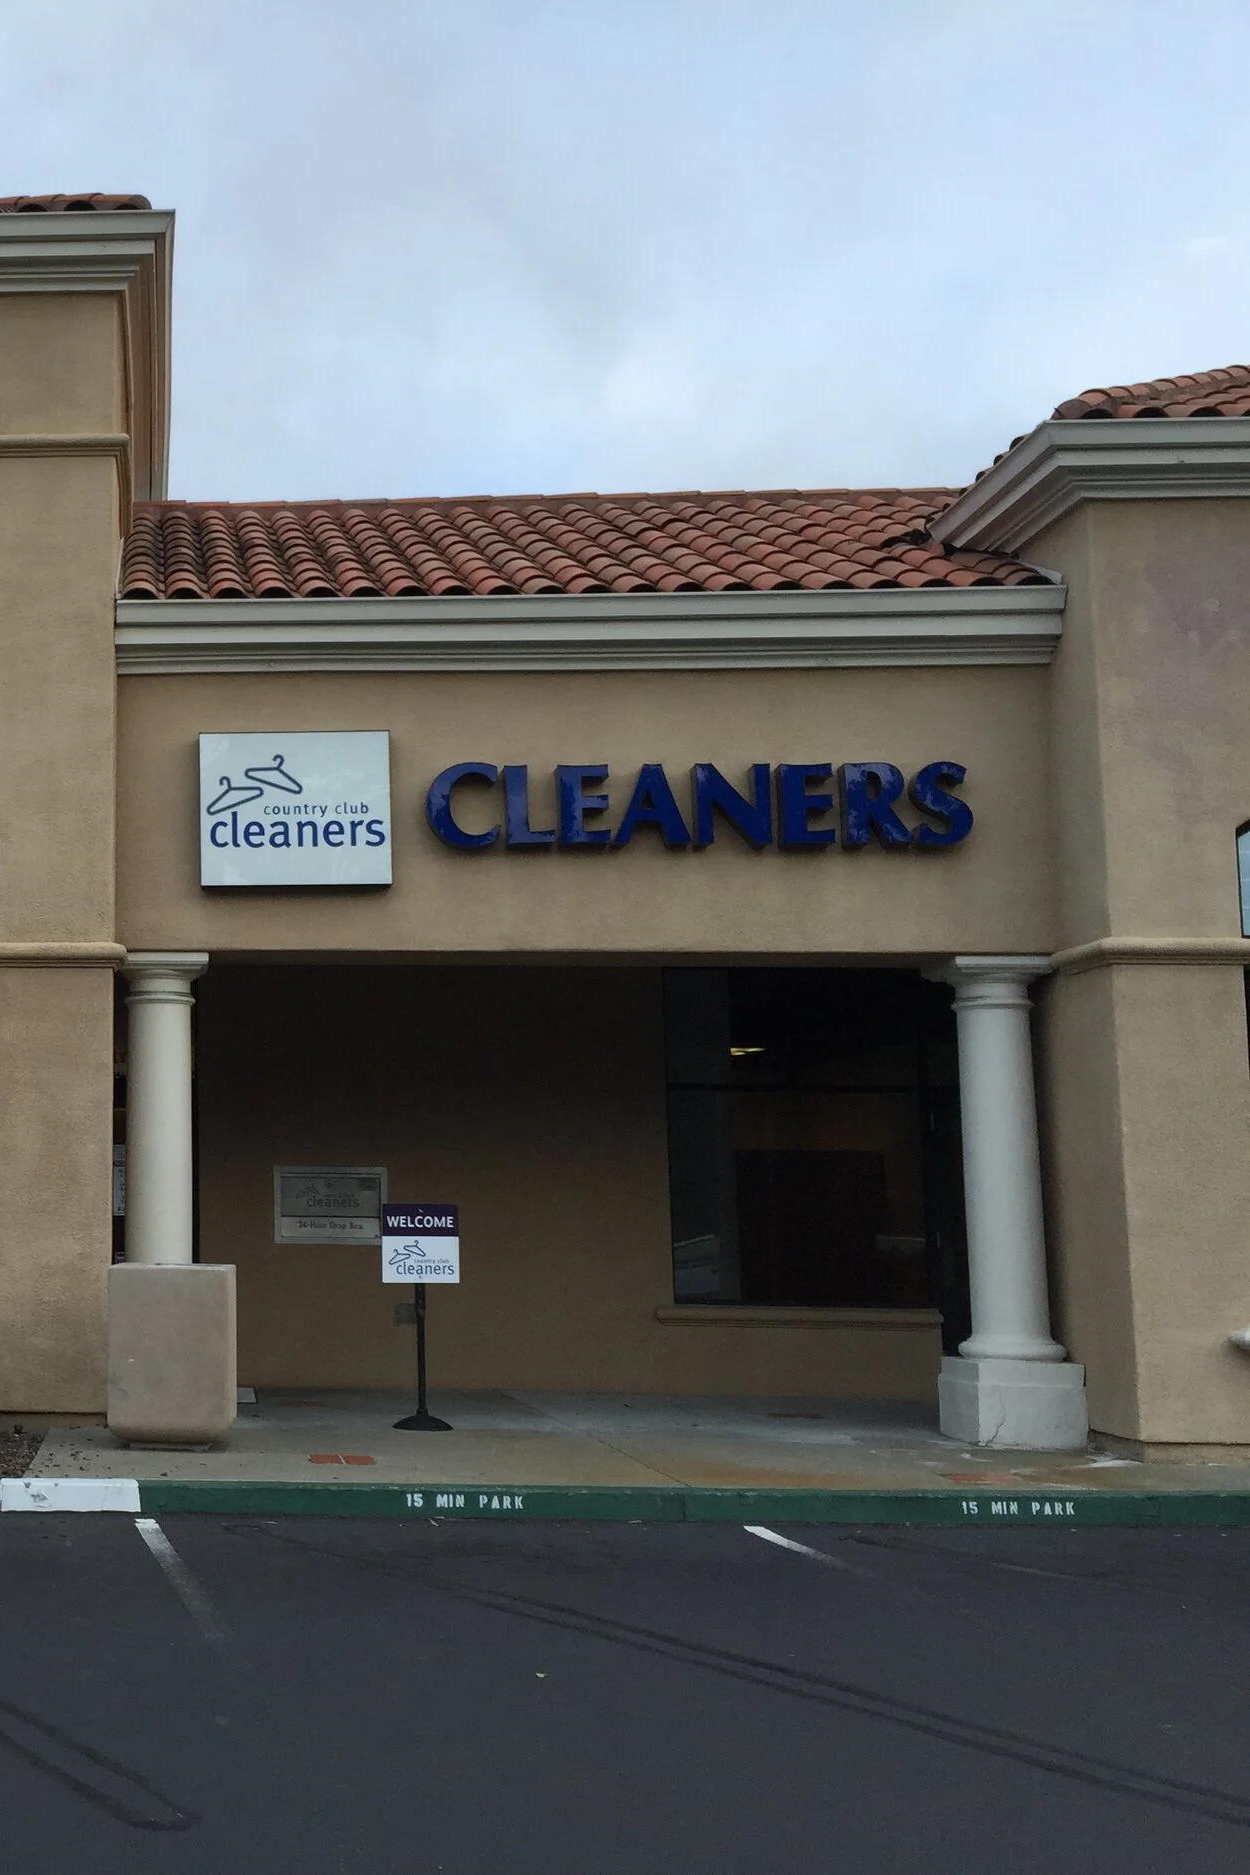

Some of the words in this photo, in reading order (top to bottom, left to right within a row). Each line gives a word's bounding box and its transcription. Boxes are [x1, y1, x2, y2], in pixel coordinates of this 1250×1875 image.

[263, 803, 328, 817] country
[335, 802, 369, 815] club
[425, 761, 975, 848] CLEANERS
[210, 811, 386, 848] cleaners
[307, 1195, 360, 1208] cleaners
[329, 1221, 347, 1231] Drop
[349, 1221, 364, 1230] Box
[386, 1215, 454, 1228] WELCOME
[396, 1261, 455, 1275] cleaners
[406, 1493, 424, 1508] 15
[436, 1494, 465, 1508] MIN
[479, 1494, 524, 1509] PARK
[962, 1501, 978, 1515] 15
[991, 1501, 1018, 1515] MIN
[1031, 1502, 1075, 1515] PARK
